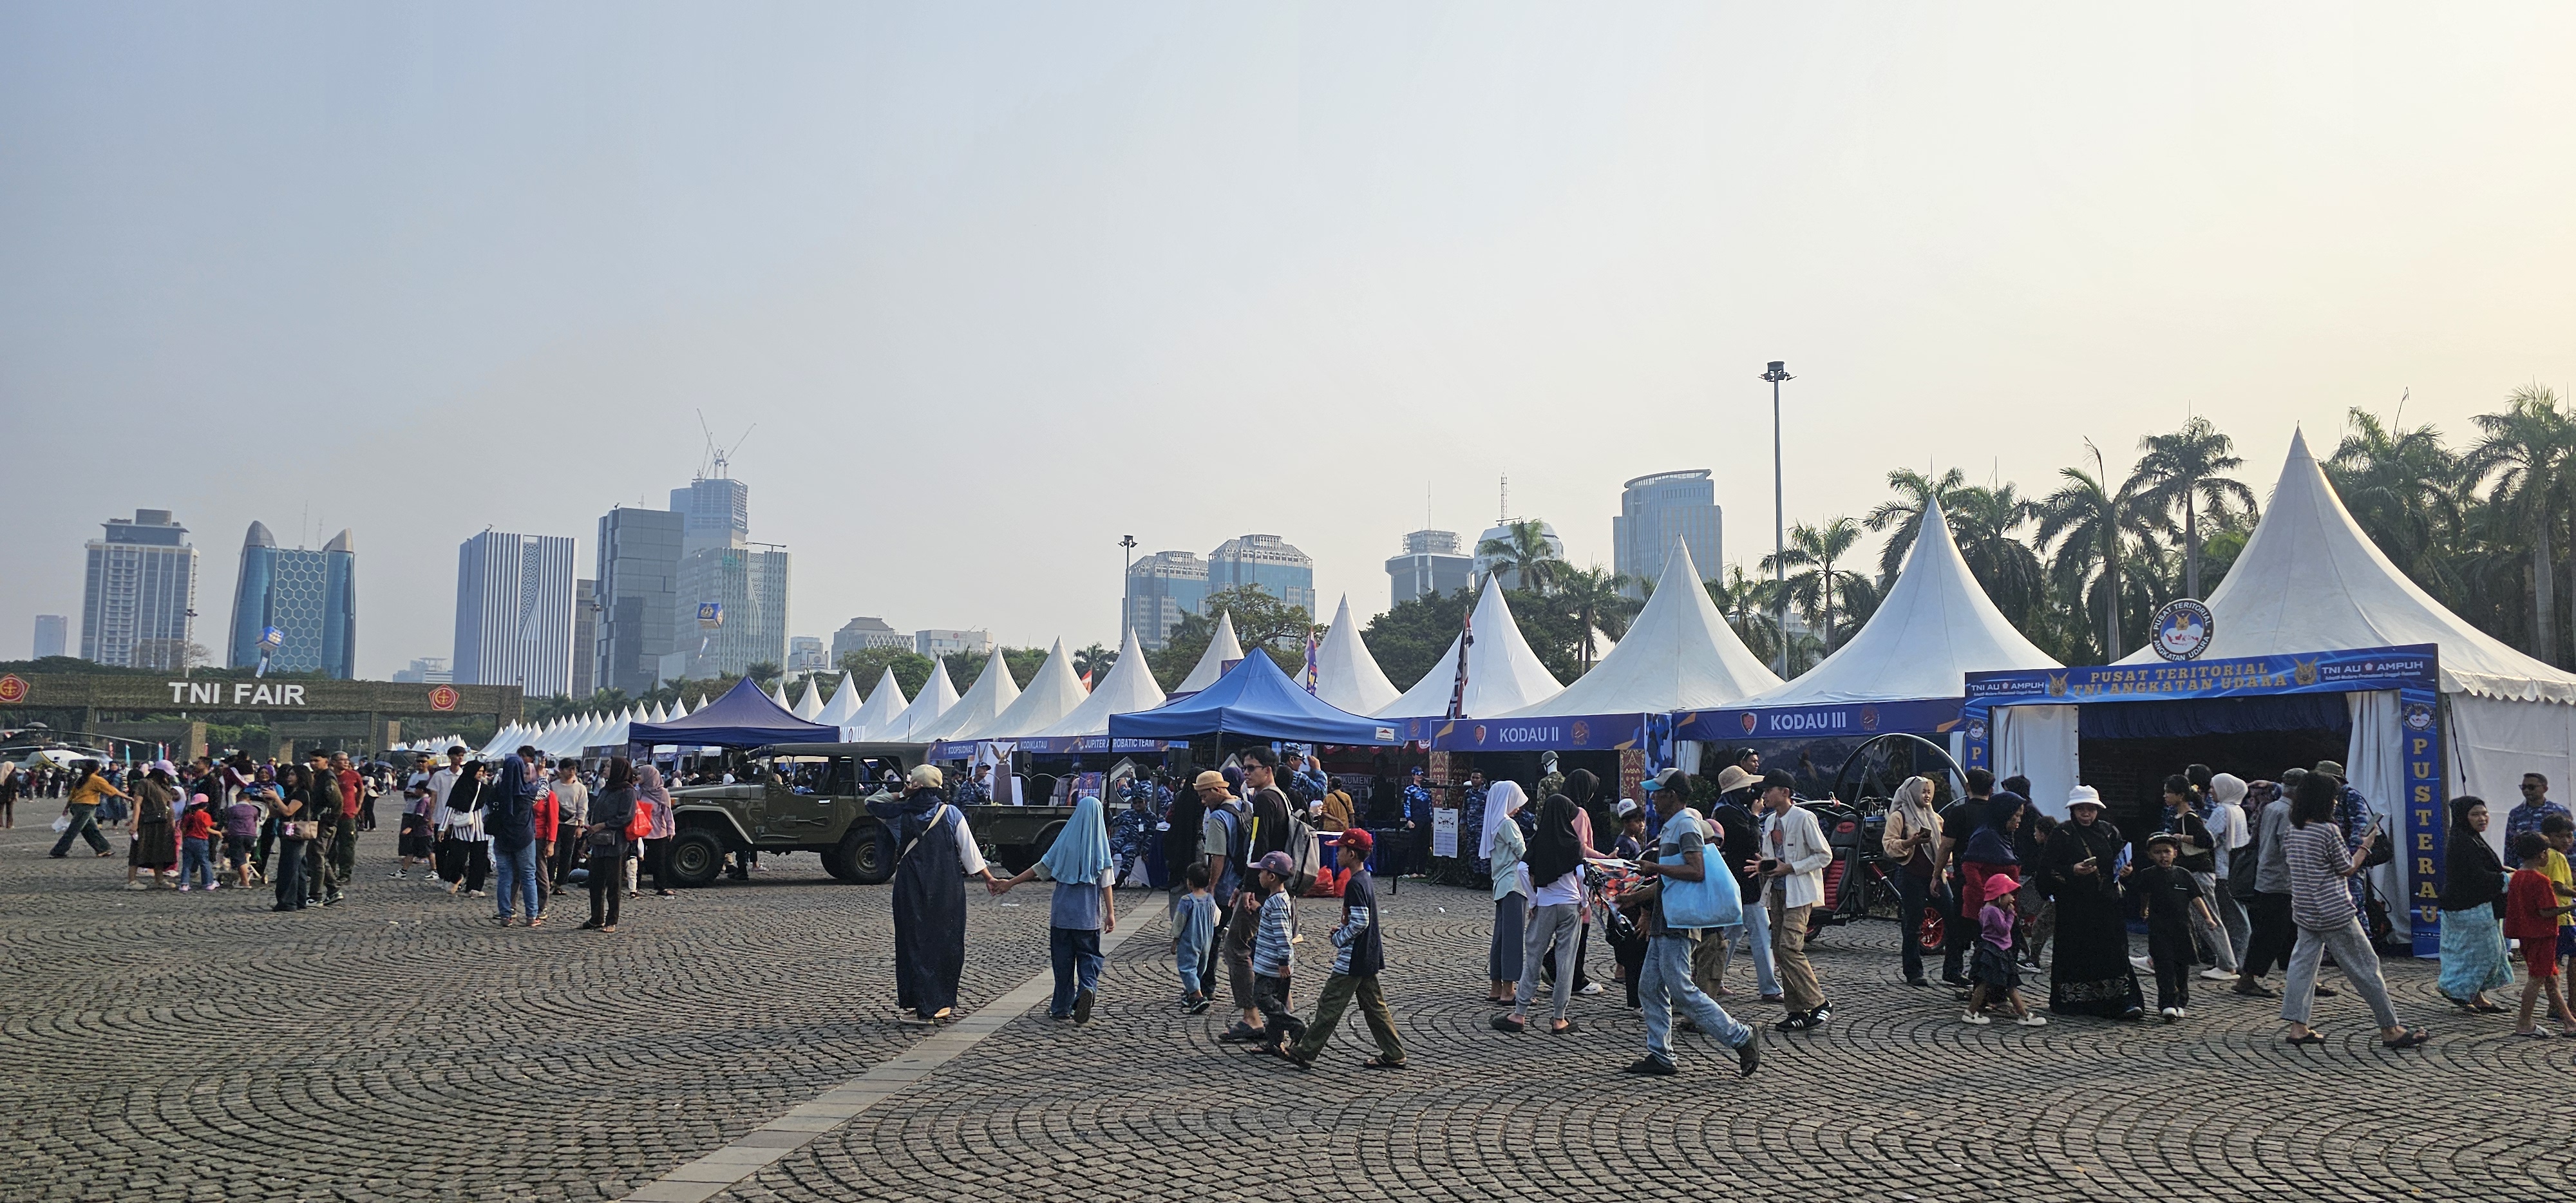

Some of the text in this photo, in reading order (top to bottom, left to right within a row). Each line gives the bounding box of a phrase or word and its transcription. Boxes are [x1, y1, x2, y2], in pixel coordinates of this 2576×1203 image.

[2153, 602, 2211, 630] PUSAT TERITORIAL
[2153, 636, 2210, 661] ANGKATAN UDARA
[2090, 662, 2268, 683] PUSAT TERITORIAL
[2322, 666, 2340, 674] TNI
[2376, 661, 2423, 671] AMPUH
[168, 682, 306, 705] TNI FAIR
[2073, 674, 2287, 696] TNI ANGKATAN UDARA
[1771, 712, 1846, 730] KODAU III
[1084, 738, 1155, 749] JUPITER AROBATIC TEAM
[1499, 726, 1558, 743] KODAU II
[948, 745, 974, 754] KOOPSUDNAS
[1020, 740, 1048, 749] KODIKLATAU
[2412, 739, 2438, 923] PUSTERAU
